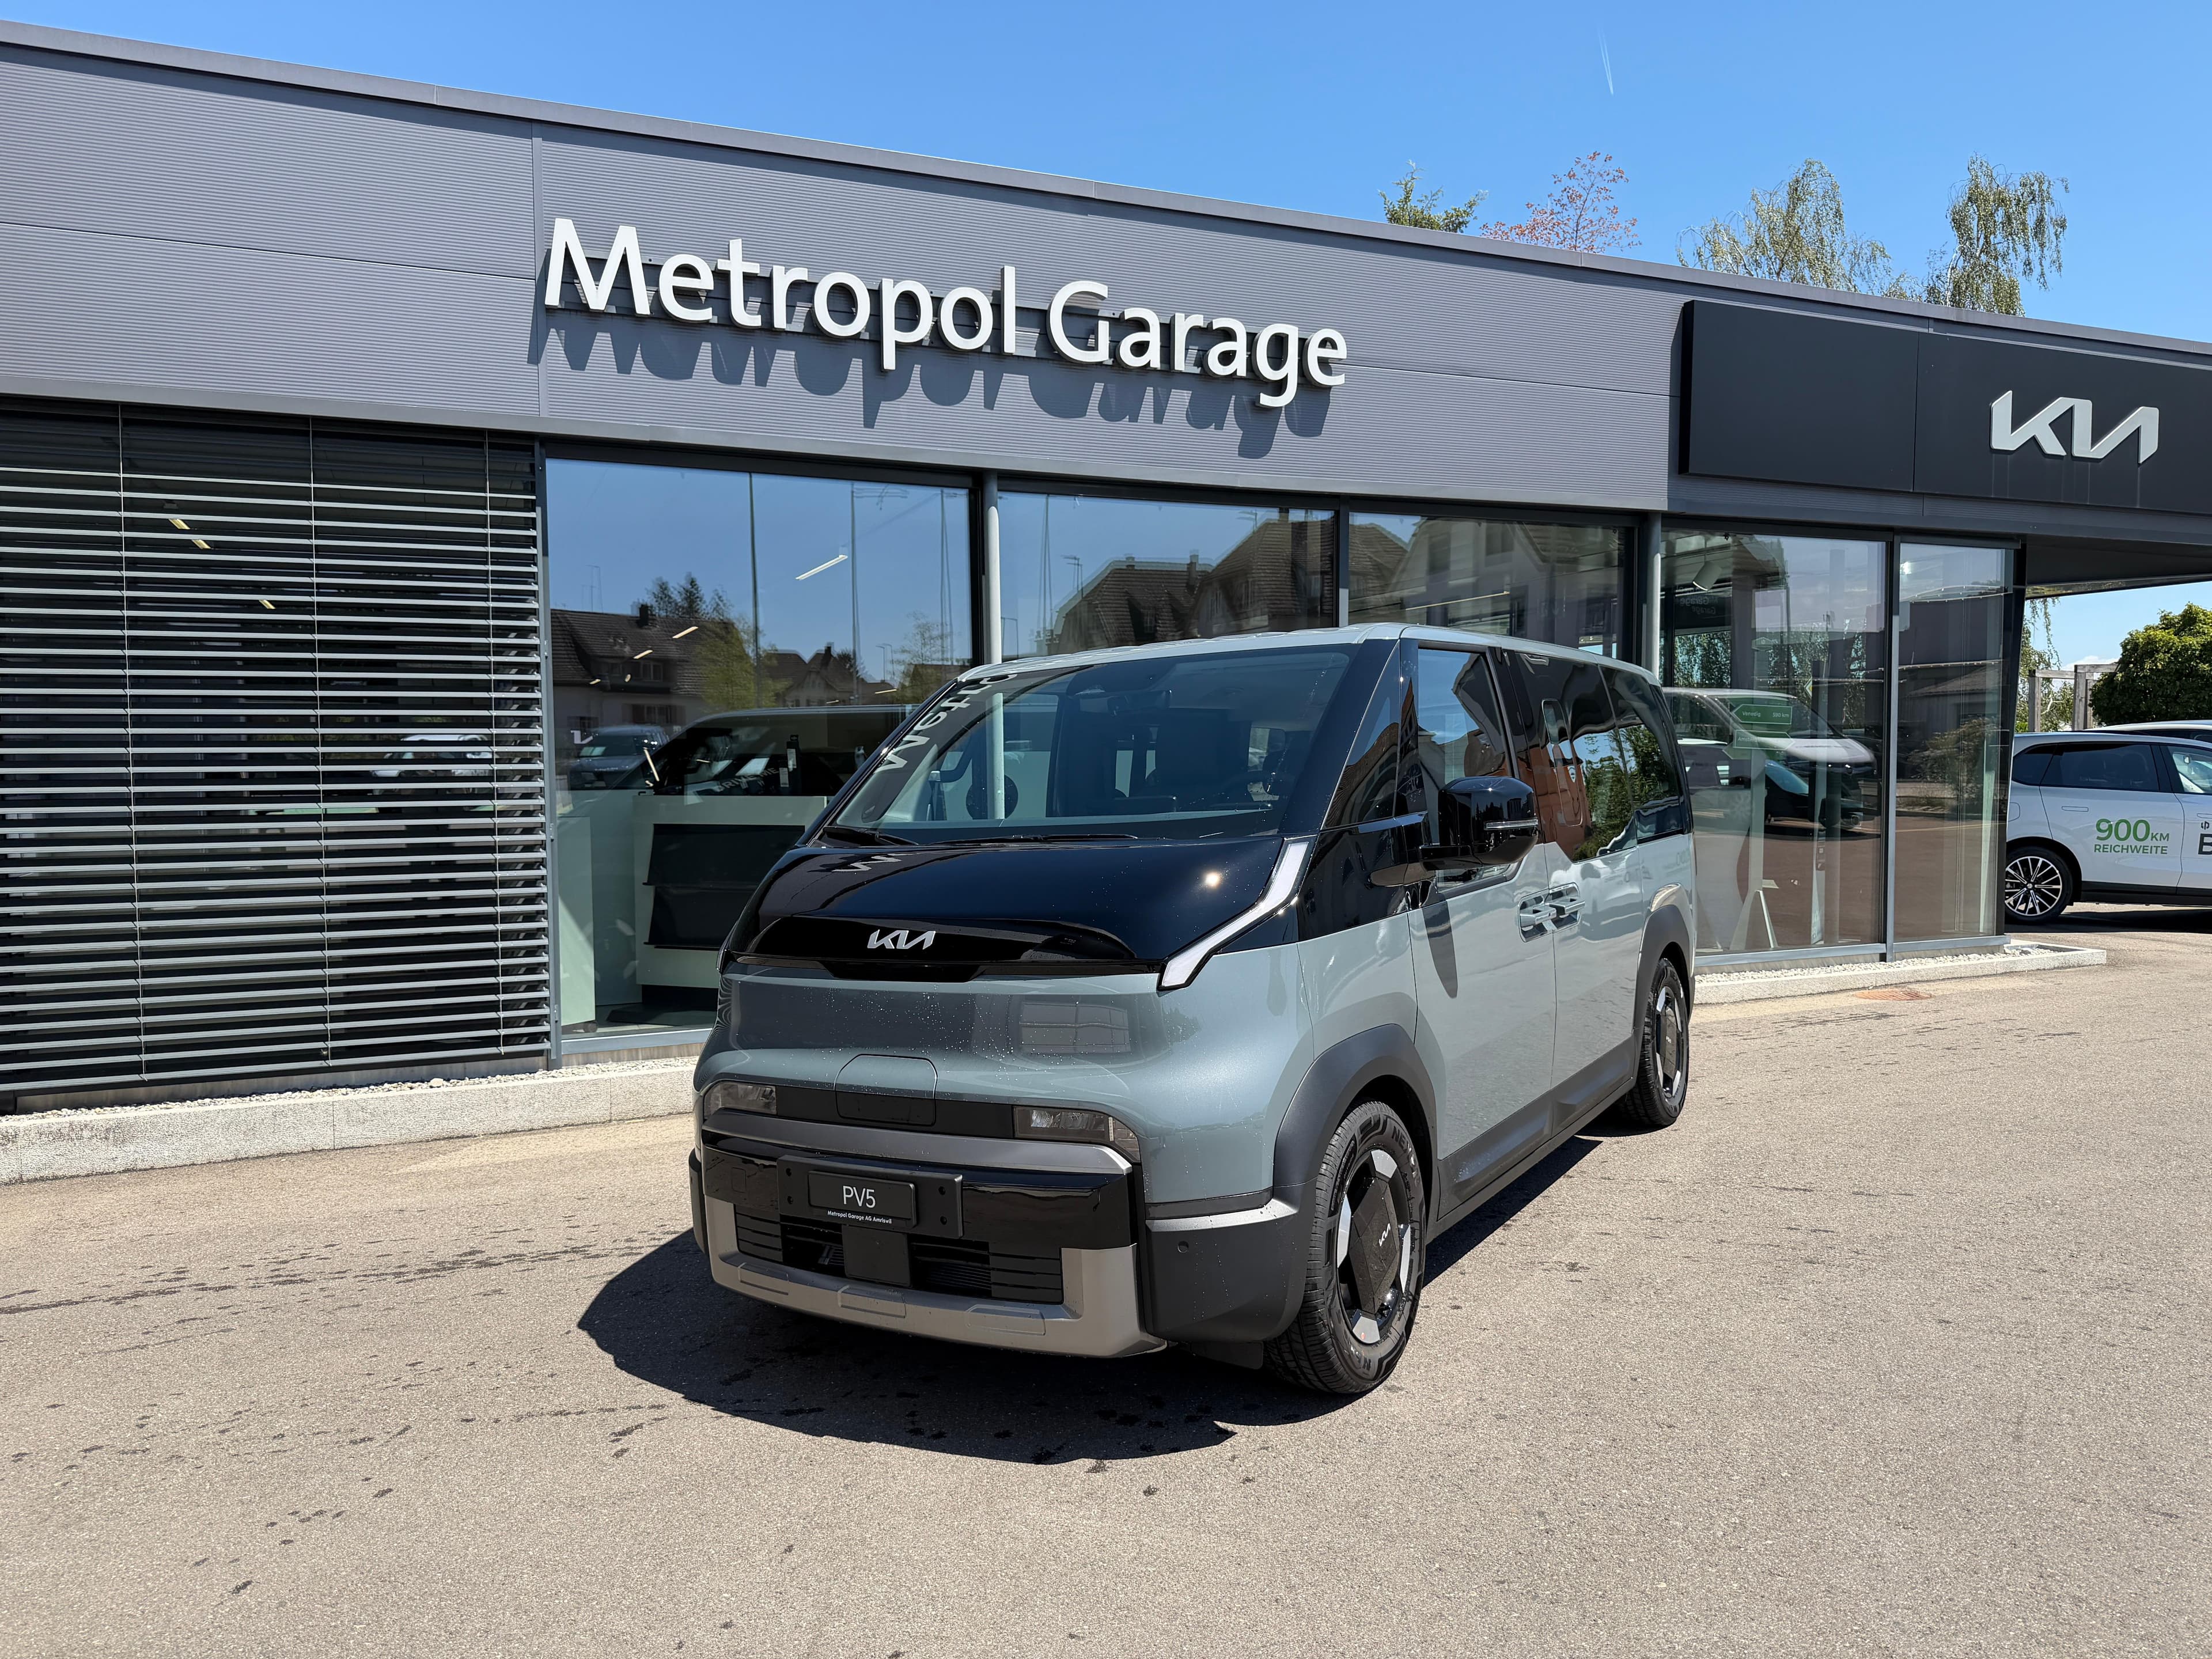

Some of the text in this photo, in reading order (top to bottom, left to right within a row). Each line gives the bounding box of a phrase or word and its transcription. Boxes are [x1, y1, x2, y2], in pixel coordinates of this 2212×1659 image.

[544, 218, 1347, 408] Metropol Garage
[1990, 390, 2160, 464] KIA
[2093, 844, 2169, 855] REICHWEITE
[867, 929, 936, 950] KIA
[843, 1185, 876, 1209] PV5
[873, 1217, 892, 1225] Amriswil
